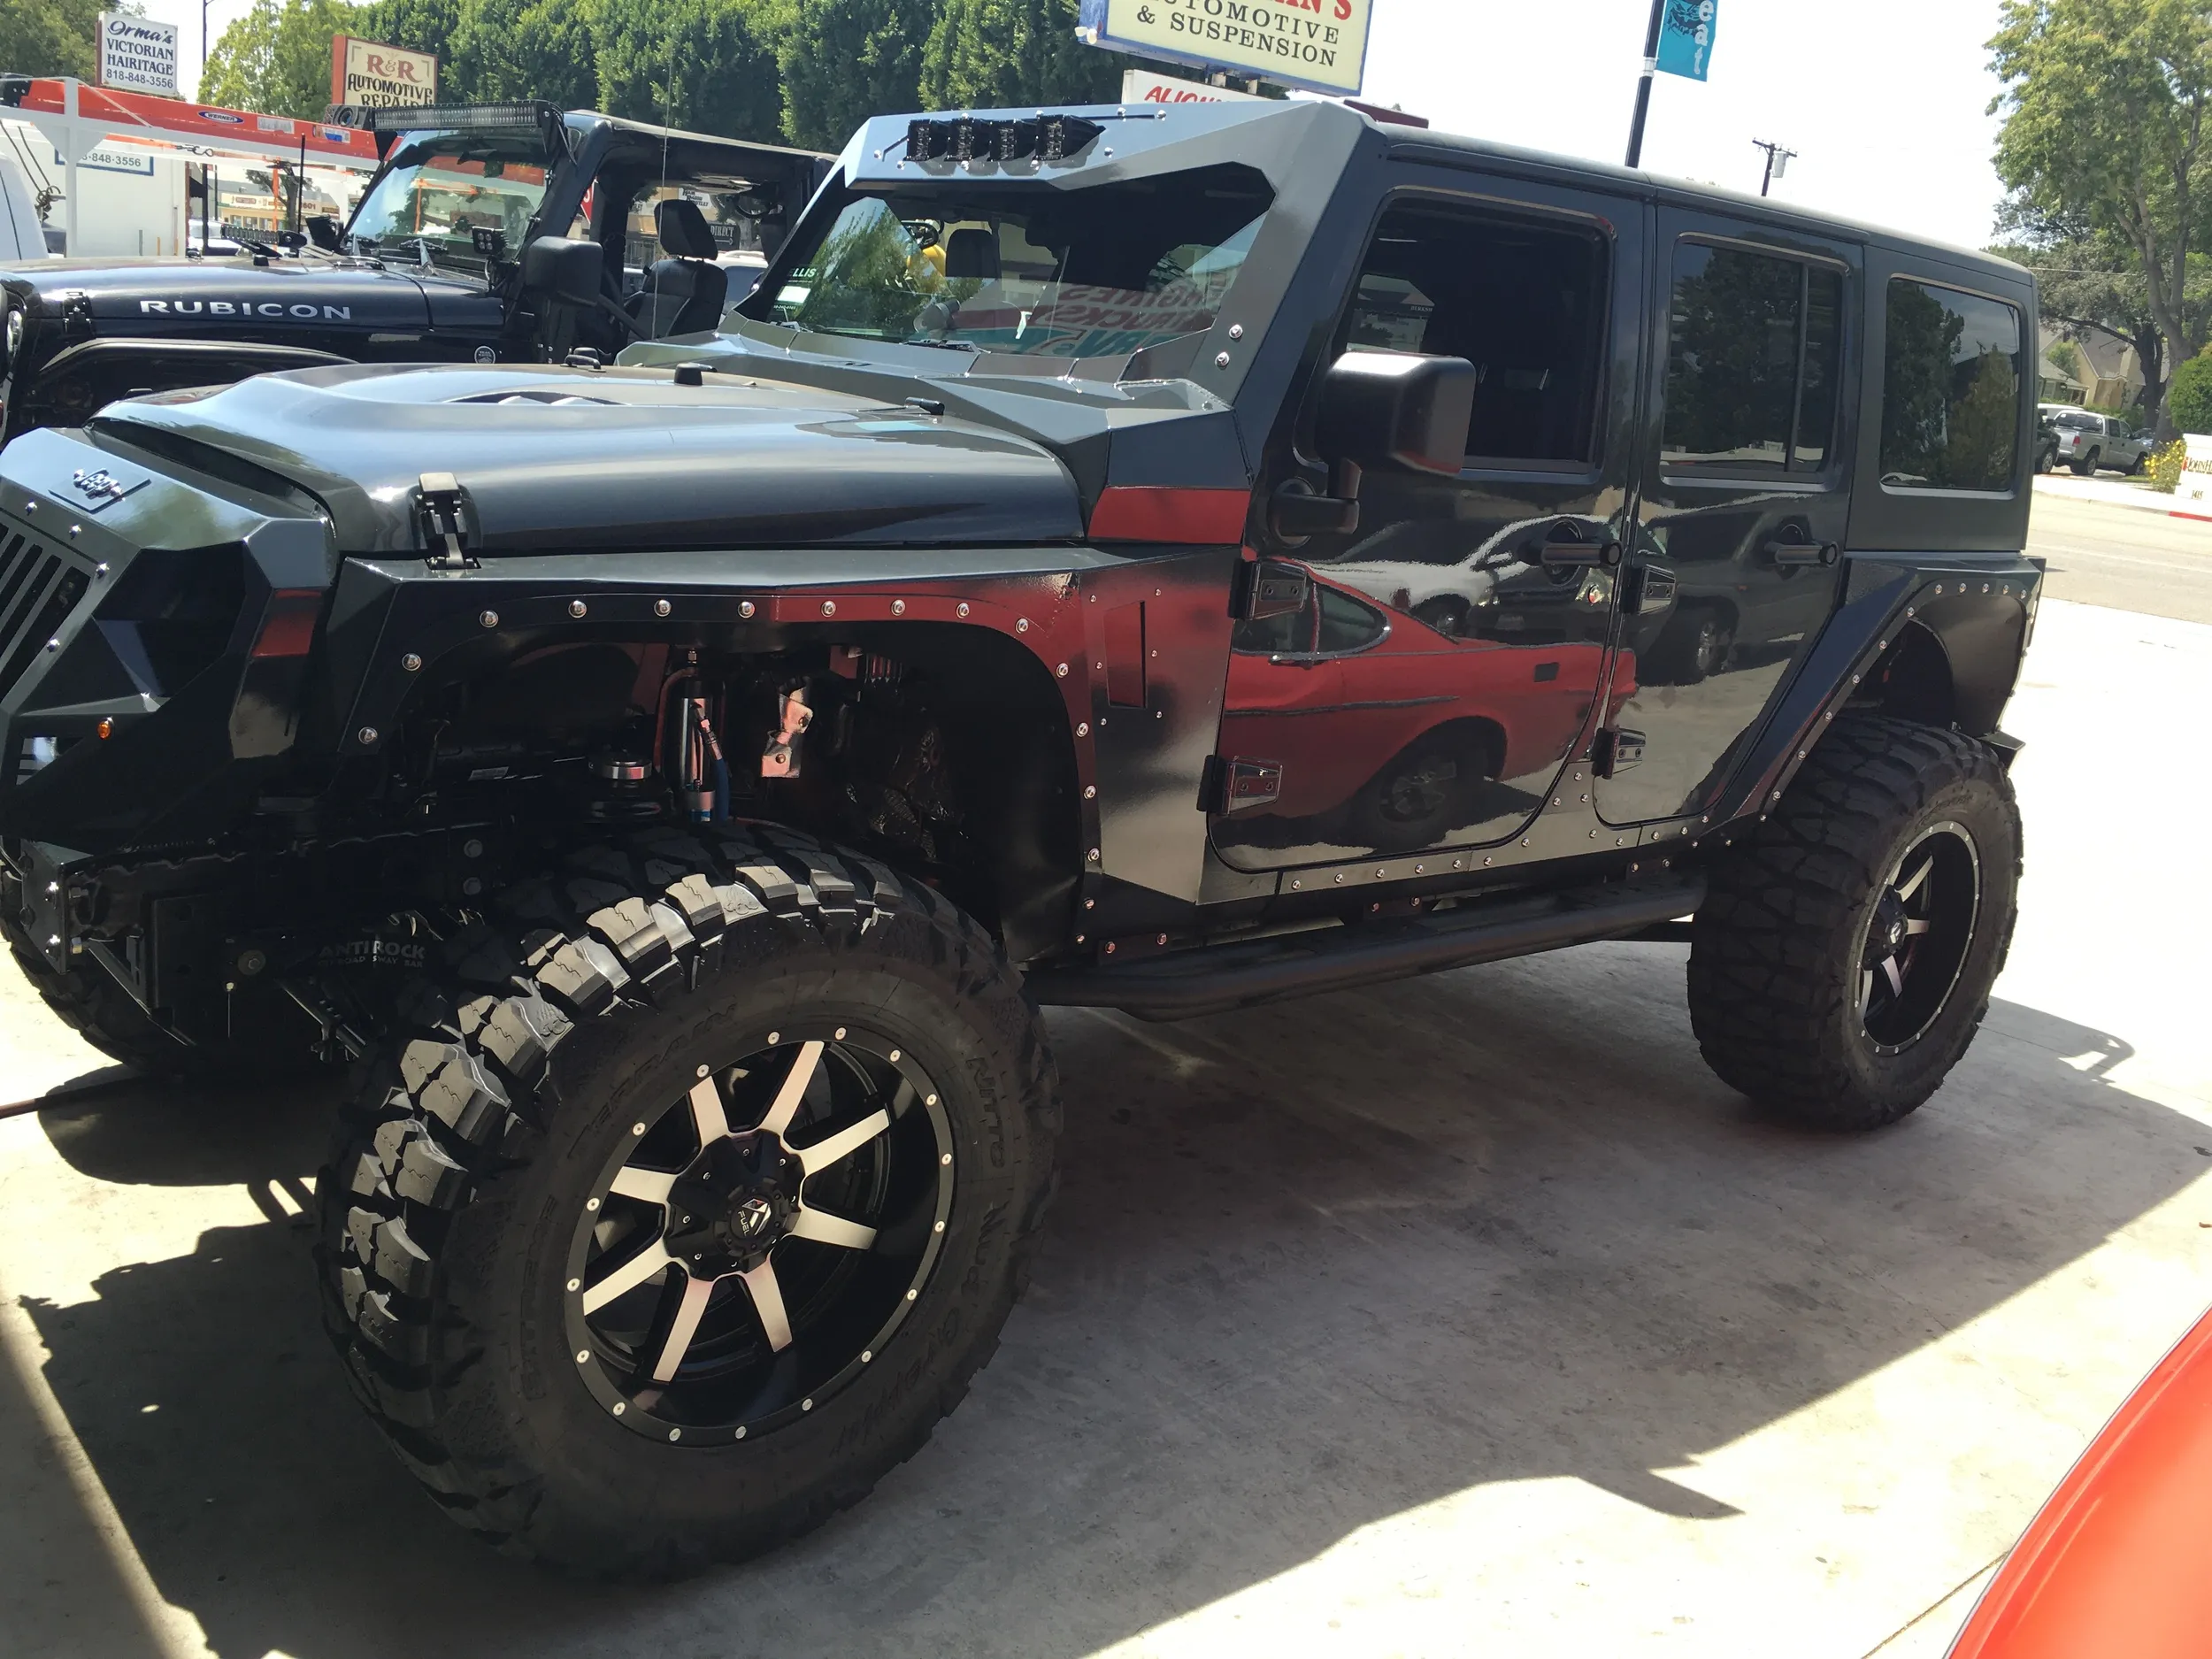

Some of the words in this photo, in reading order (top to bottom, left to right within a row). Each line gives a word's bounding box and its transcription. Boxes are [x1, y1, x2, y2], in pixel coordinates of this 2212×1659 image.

[107, 20, 173, 44] Orma's
[1153, 0, 1340, 44] TOMOTIVE
[1136, 4, 1156, 25] &
[1170, 12, 1337, 67] SUSPENSION
[106, 38, 173, 61] VICTORIAN
[107, 53, 173, 76] HAIRITAGE
[106, 68, 173, 88] 818-848-3556
[347, 73, 433, 104] AUTOMOTIVE
[208, 112, 235, 122] WERNER
[140, 300, 351, 319] RUBICON
[319, 940, 426, 959] ANTIROCK
[965, 1057, 1006, 1169] NITTO
[737, 1210, 749, 1237] FUEL
